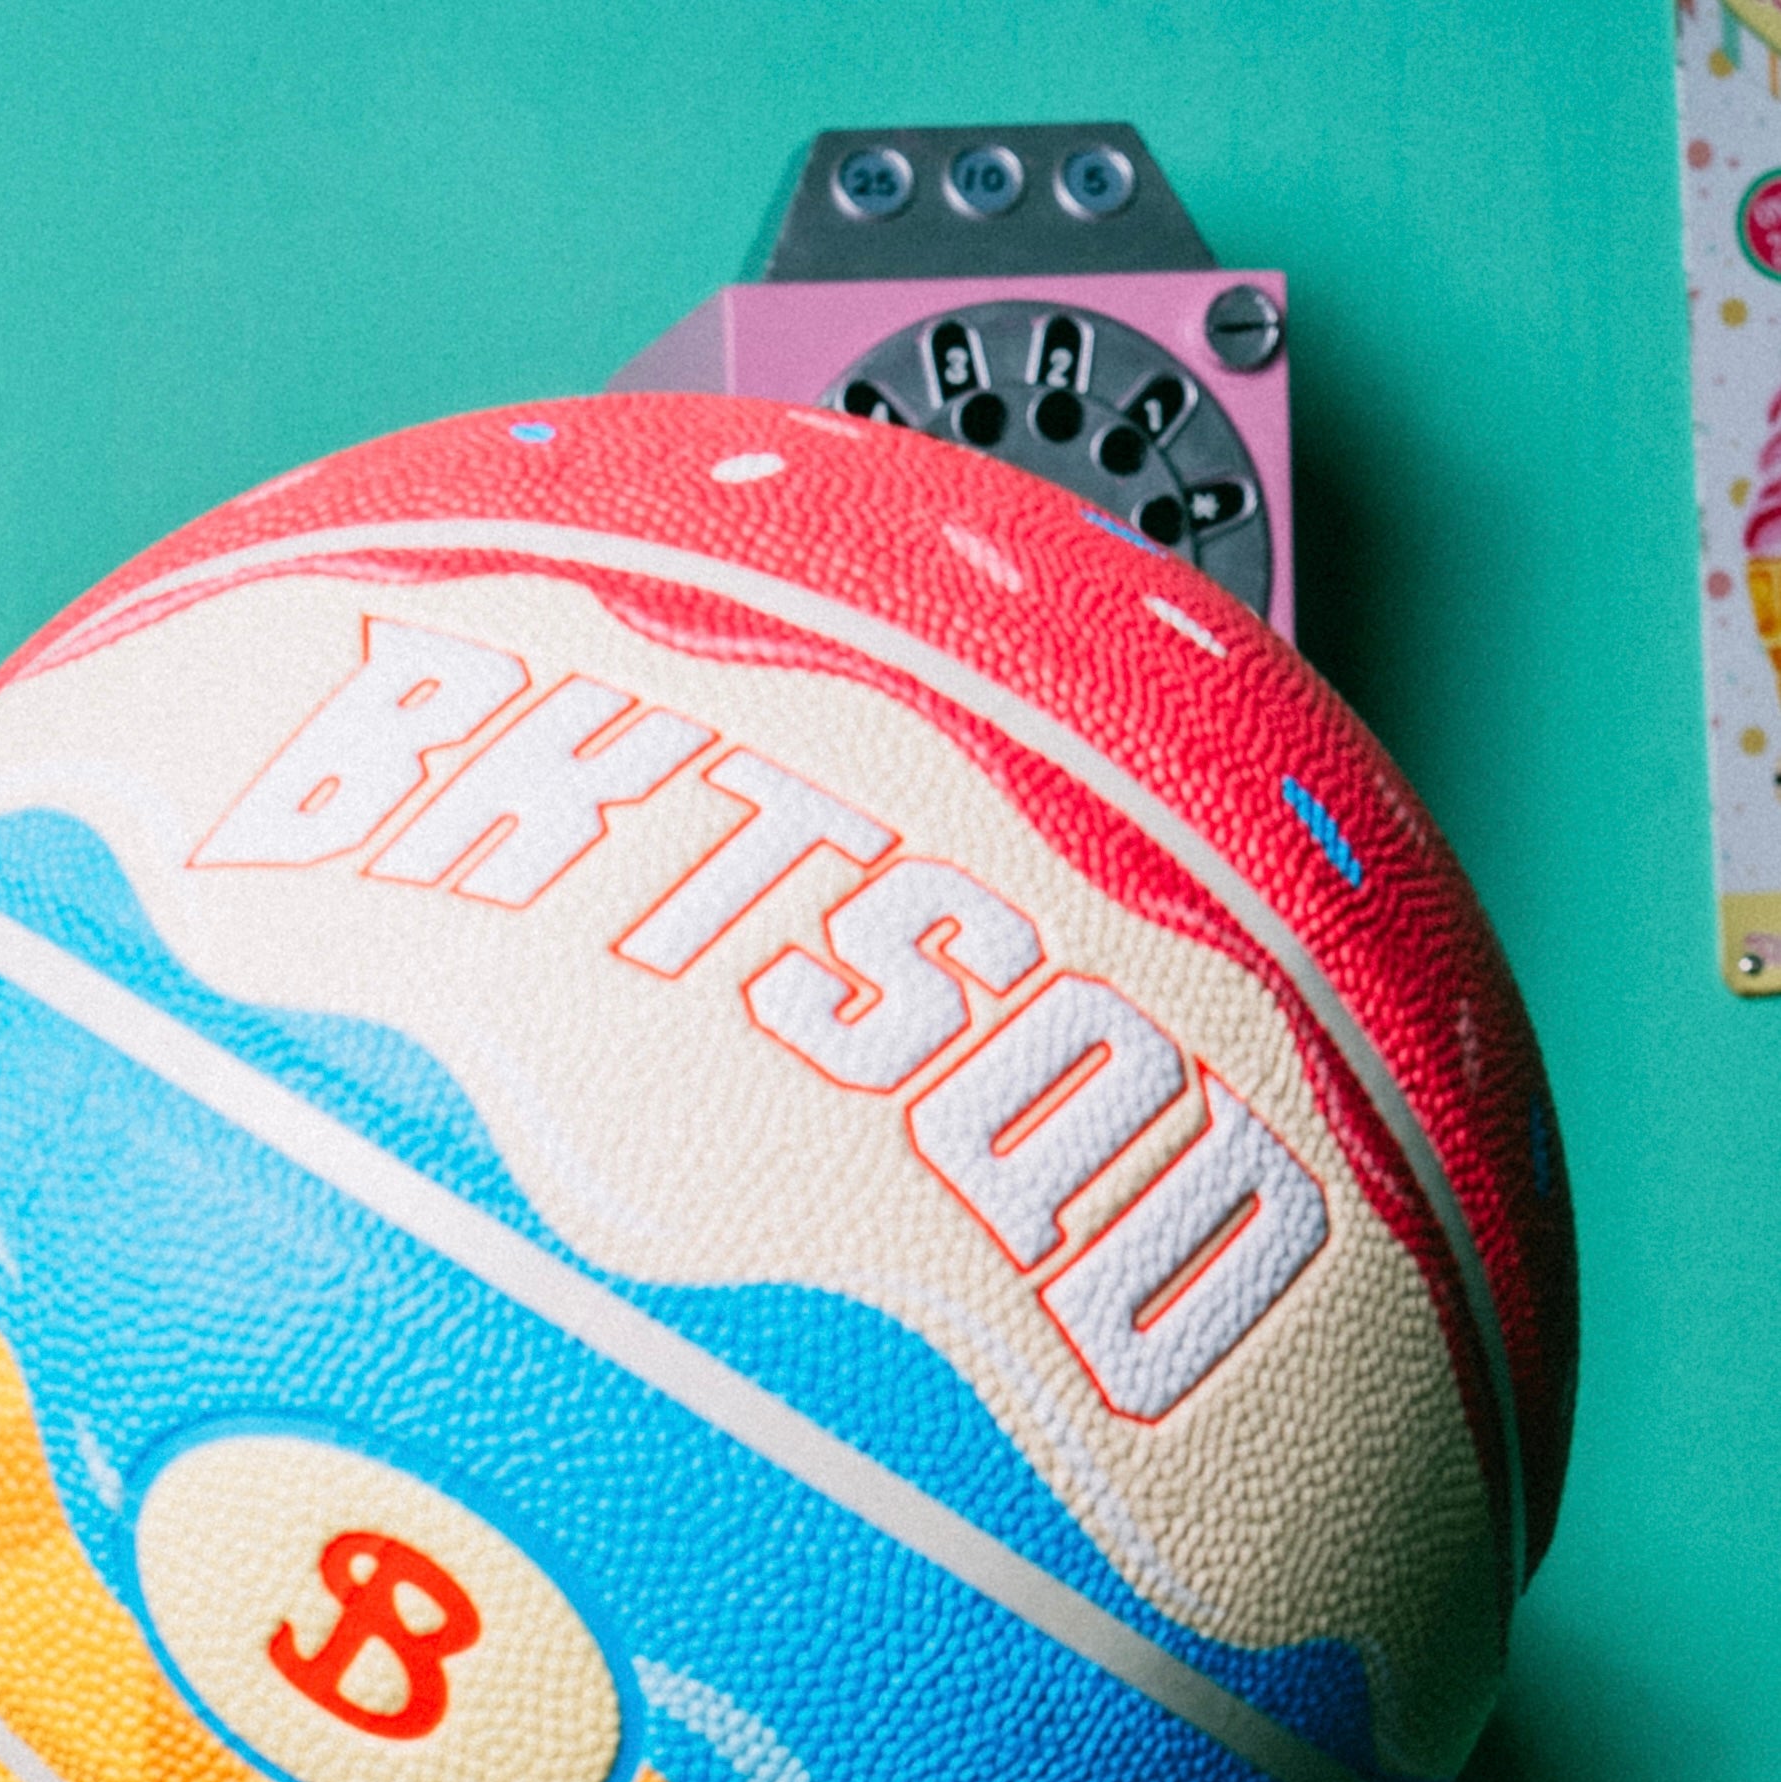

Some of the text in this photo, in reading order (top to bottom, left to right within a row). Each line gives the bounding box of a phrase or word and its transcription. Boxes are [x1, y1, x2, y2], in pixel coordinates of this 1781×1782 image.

[853, 164, 1108, 197] 25 10 5
[943, 346, 970, 386] 3
[1046, 347, 1075, 387] 2
[1143, 399, 1164, 432] 1
[185, 614, 1330, 1425] BKTSQD
